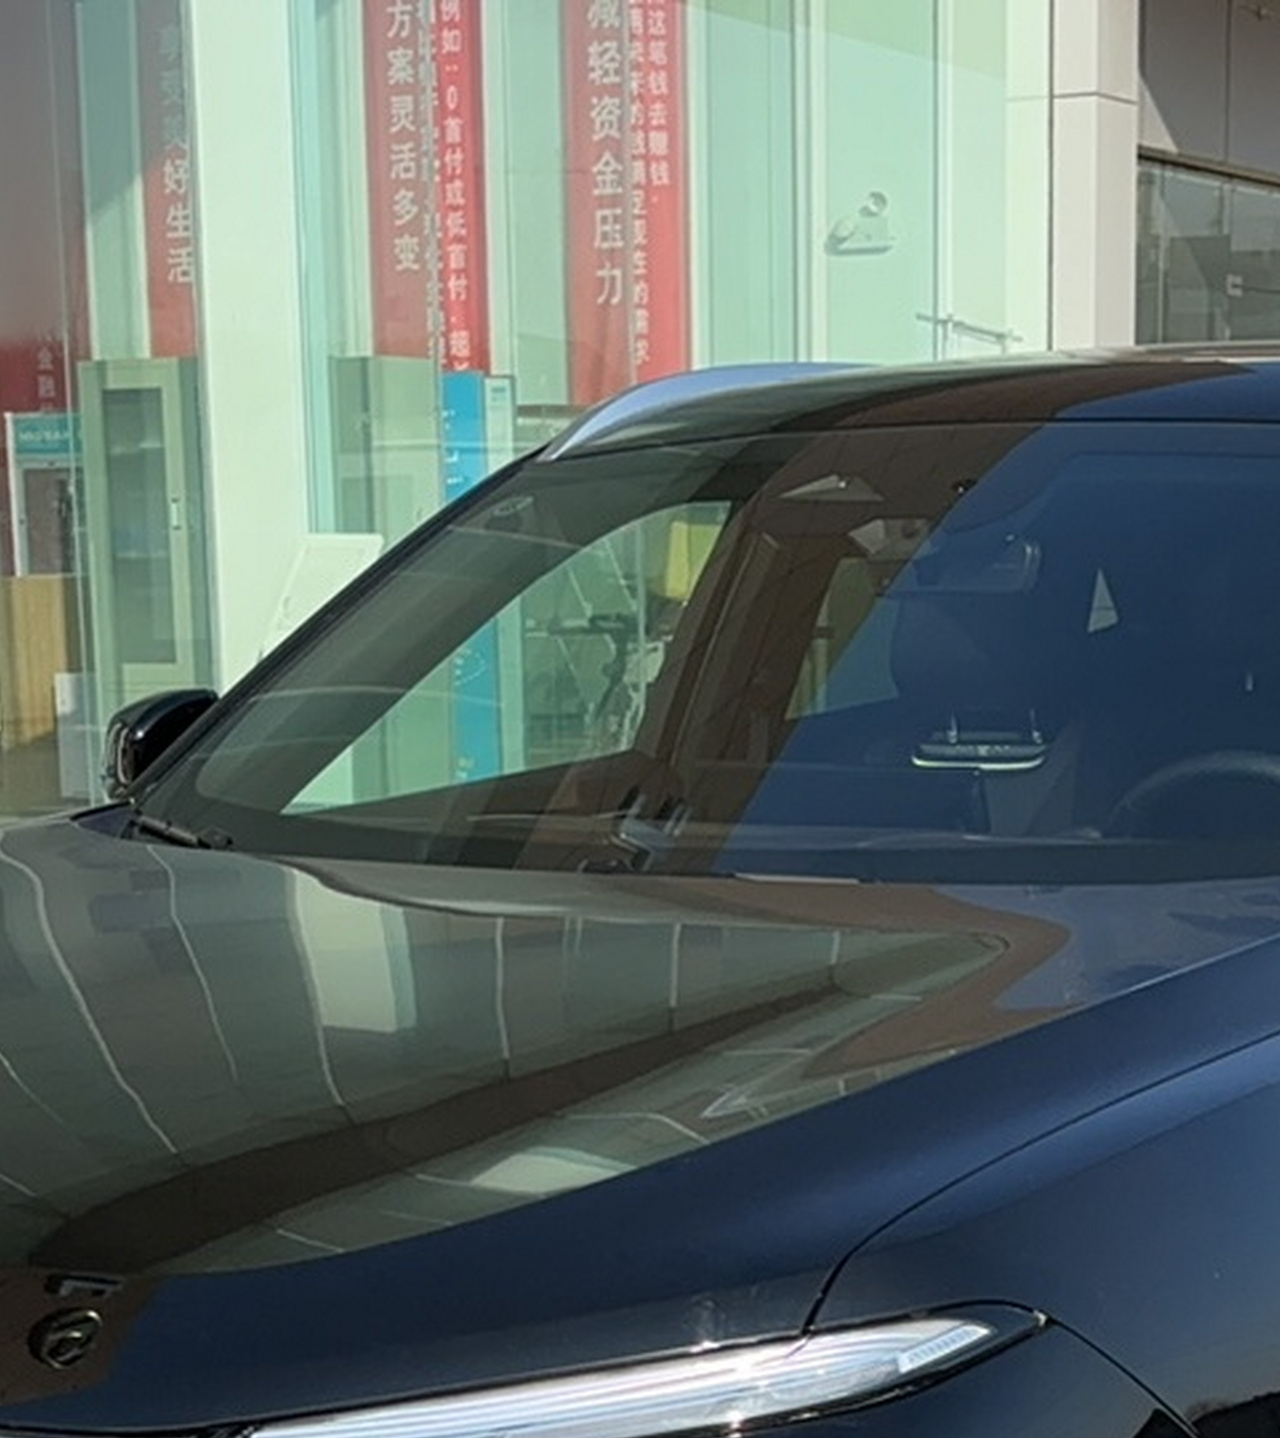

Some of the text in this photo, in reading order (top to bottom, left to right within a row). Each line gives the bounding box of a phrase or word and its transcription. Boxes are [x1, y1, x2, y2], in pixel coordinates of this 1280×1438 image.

[384, 0, 420, 271] 方案灵活多变
